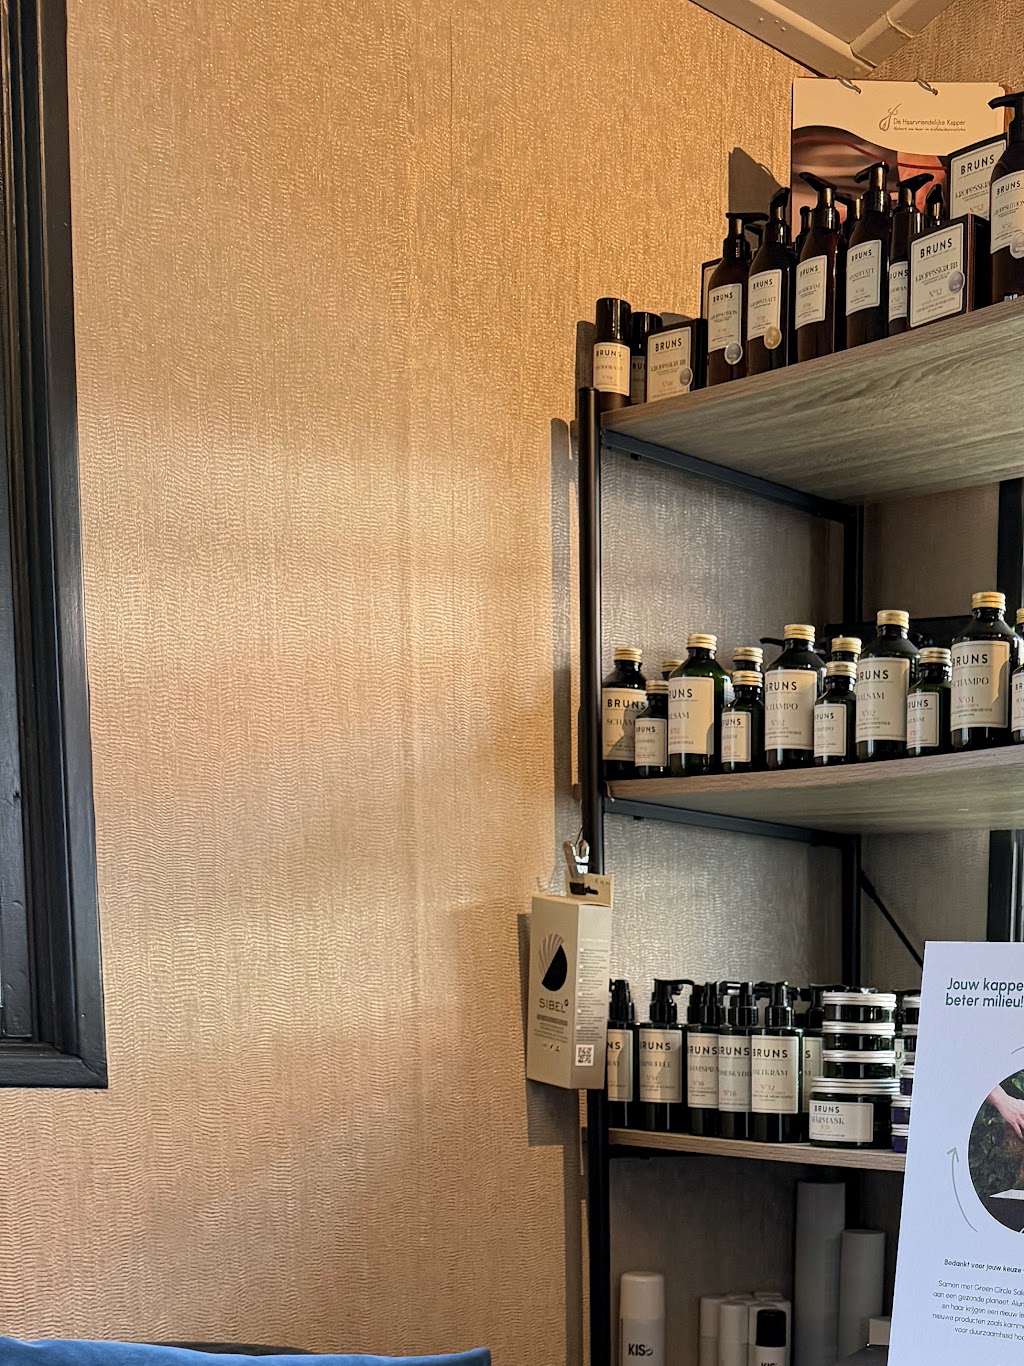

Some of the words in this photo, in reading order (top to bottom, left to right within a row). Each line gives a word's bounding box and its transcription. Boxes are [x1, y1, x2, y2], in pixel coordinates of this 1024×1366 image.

[946, 120, 966, 128] Kapper
[960, 154, 995, 175] BRUNS
[996, 180, 1022, 196] BRUNS
[851, 249, 872, 262] BRUNS
[920, 238, 954, 259] BRUNS
[800, 264, 819, 278] BRUNS
[753, 278, 773, 290] BRUNS
[713, 292, 733, 304] BRUNS
[655, 338, 682, 352] BRUNS
[596, 349, 622, 358] BRUNS
[952, 654, 988, 668] BRUNS
[607, 698, 646, 712] BRUNS
[946, 978, 980, 990] Jouw
[538, 998, 566, 1014] SIBEL
[946, 993, 980, 1006] beter
[982, 996, 1024, 1008] milieu!
[814, 1105, 840, 1114] BRUNS
[944, 1258, 970, 1268] Bedankt
[971, 1262, 986, 1270] voor
[986, 1264, 1002, 1272] jouw
[1003, 1266, 1022, 1274] keuze
[938, 1280, 960, 1289] Samen
[960, 1282, 973, 1290] met
[974, 1284, 994, 1292] Green
[994, 1286, 1012, 1295] Circle
[946, 1292, 958, 1300] een
[958, 1294, 984, 1304] gezonde
[950, 1303, 965, 1312] haar
[1000, 1309, 1018, 1318] nieuw
[932, 1312, 954, 1322] nieuwe
[954, 1315, 986, 1326] producten
[954, 1326, 968, 1334] voor
[969, 1327, 1013, 1340] duurzaamheid
